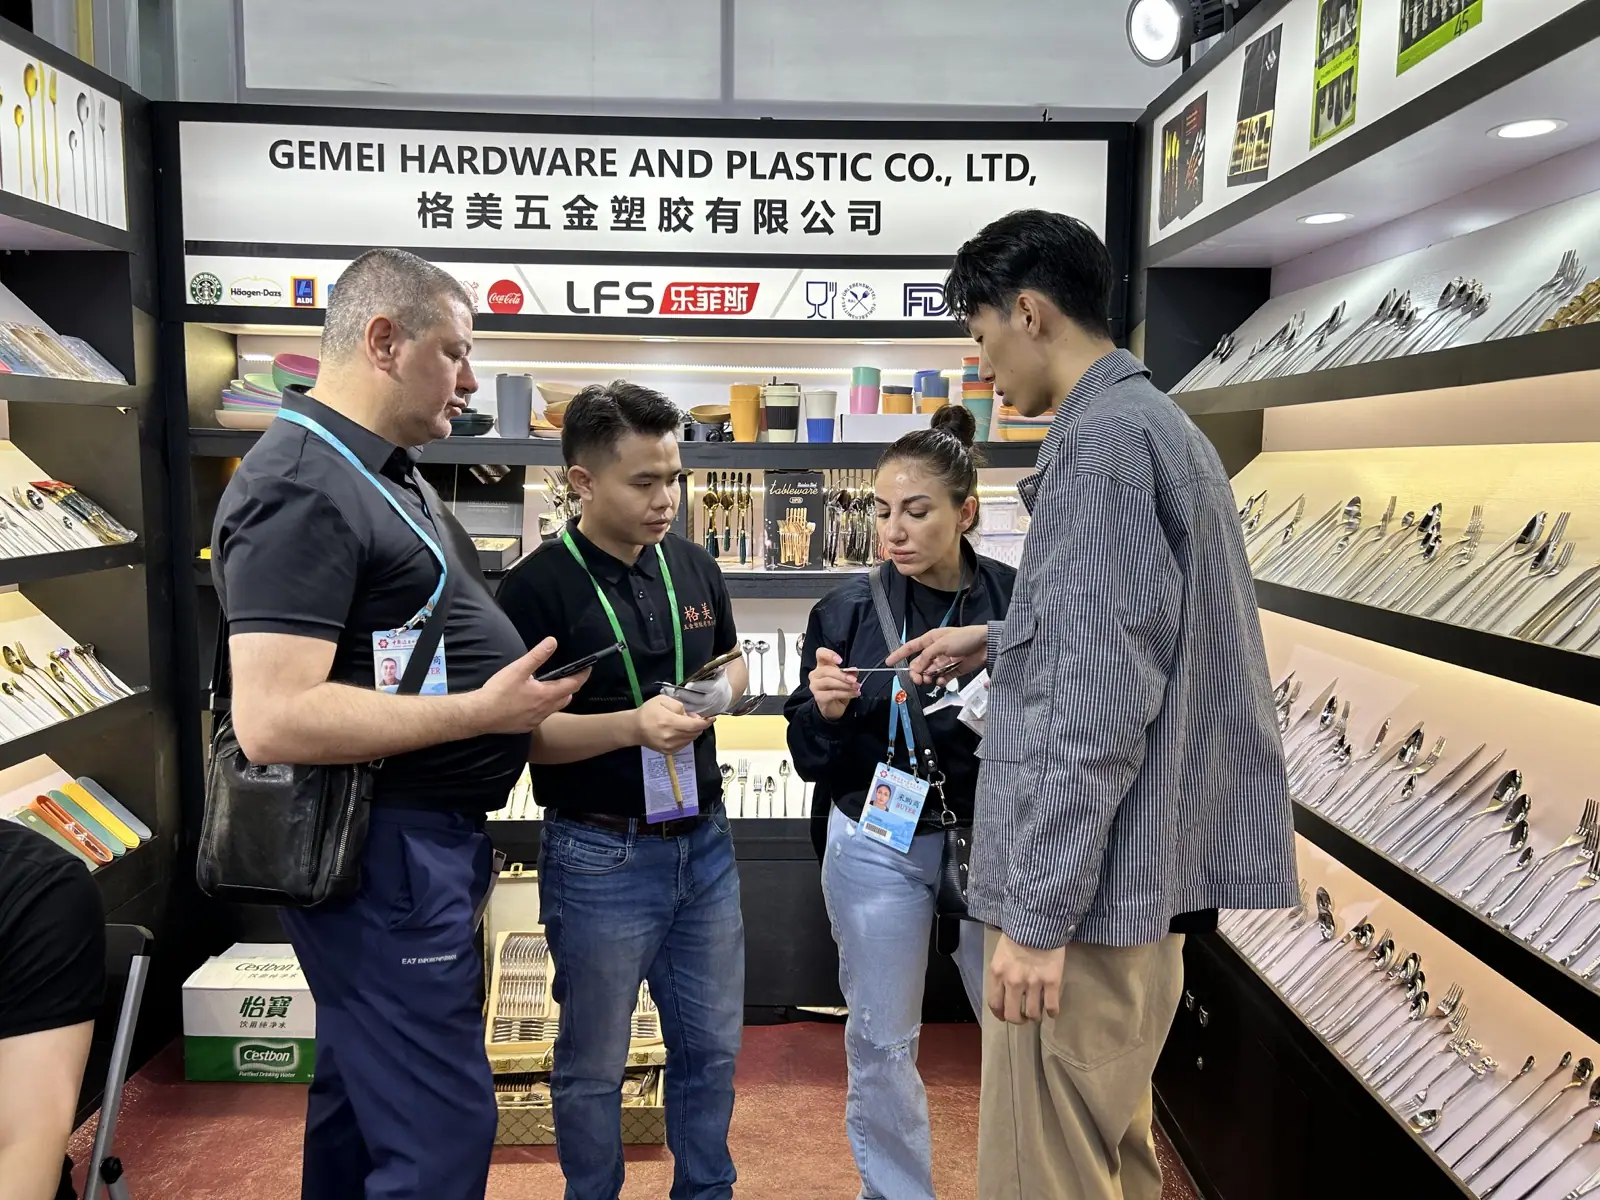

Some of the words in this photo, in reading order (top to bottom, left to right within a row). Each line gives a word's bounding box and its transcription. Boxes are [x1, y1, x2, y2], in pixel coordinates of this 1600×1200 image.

[1453, 9, 1470, 37] 45
[269, 139, 384, 172] GEMEI
[400, 144, 617, 178] HARDWARE
[629, 148, 713, 178] AND
[727, 150, 872, 182] PLASTIC
[884, 153, 952, 187] CO.,
[967, 153, 1037, 187] LTD,
[418, 191, 882, 236] 格美五金塑胶有限公司
[191, 274, 221, 288] STARBUCKS
[230, 288, 281, 298] Häagen-Dazs
[566, 280, 655, 314] LFS
[670, 285, 749, 312] 乐菲斯
[903, 283, 953, 317] FD
[769, 480, 819, 495] tableware
[684, 602, 713, 622] 格美
[896, 802, 917, 815] BUYER
[401, 957, 417, 965] EA7
[239, 995, 293, 1018] 怡寶
[259, 1071, 280, 1079] Drinking
